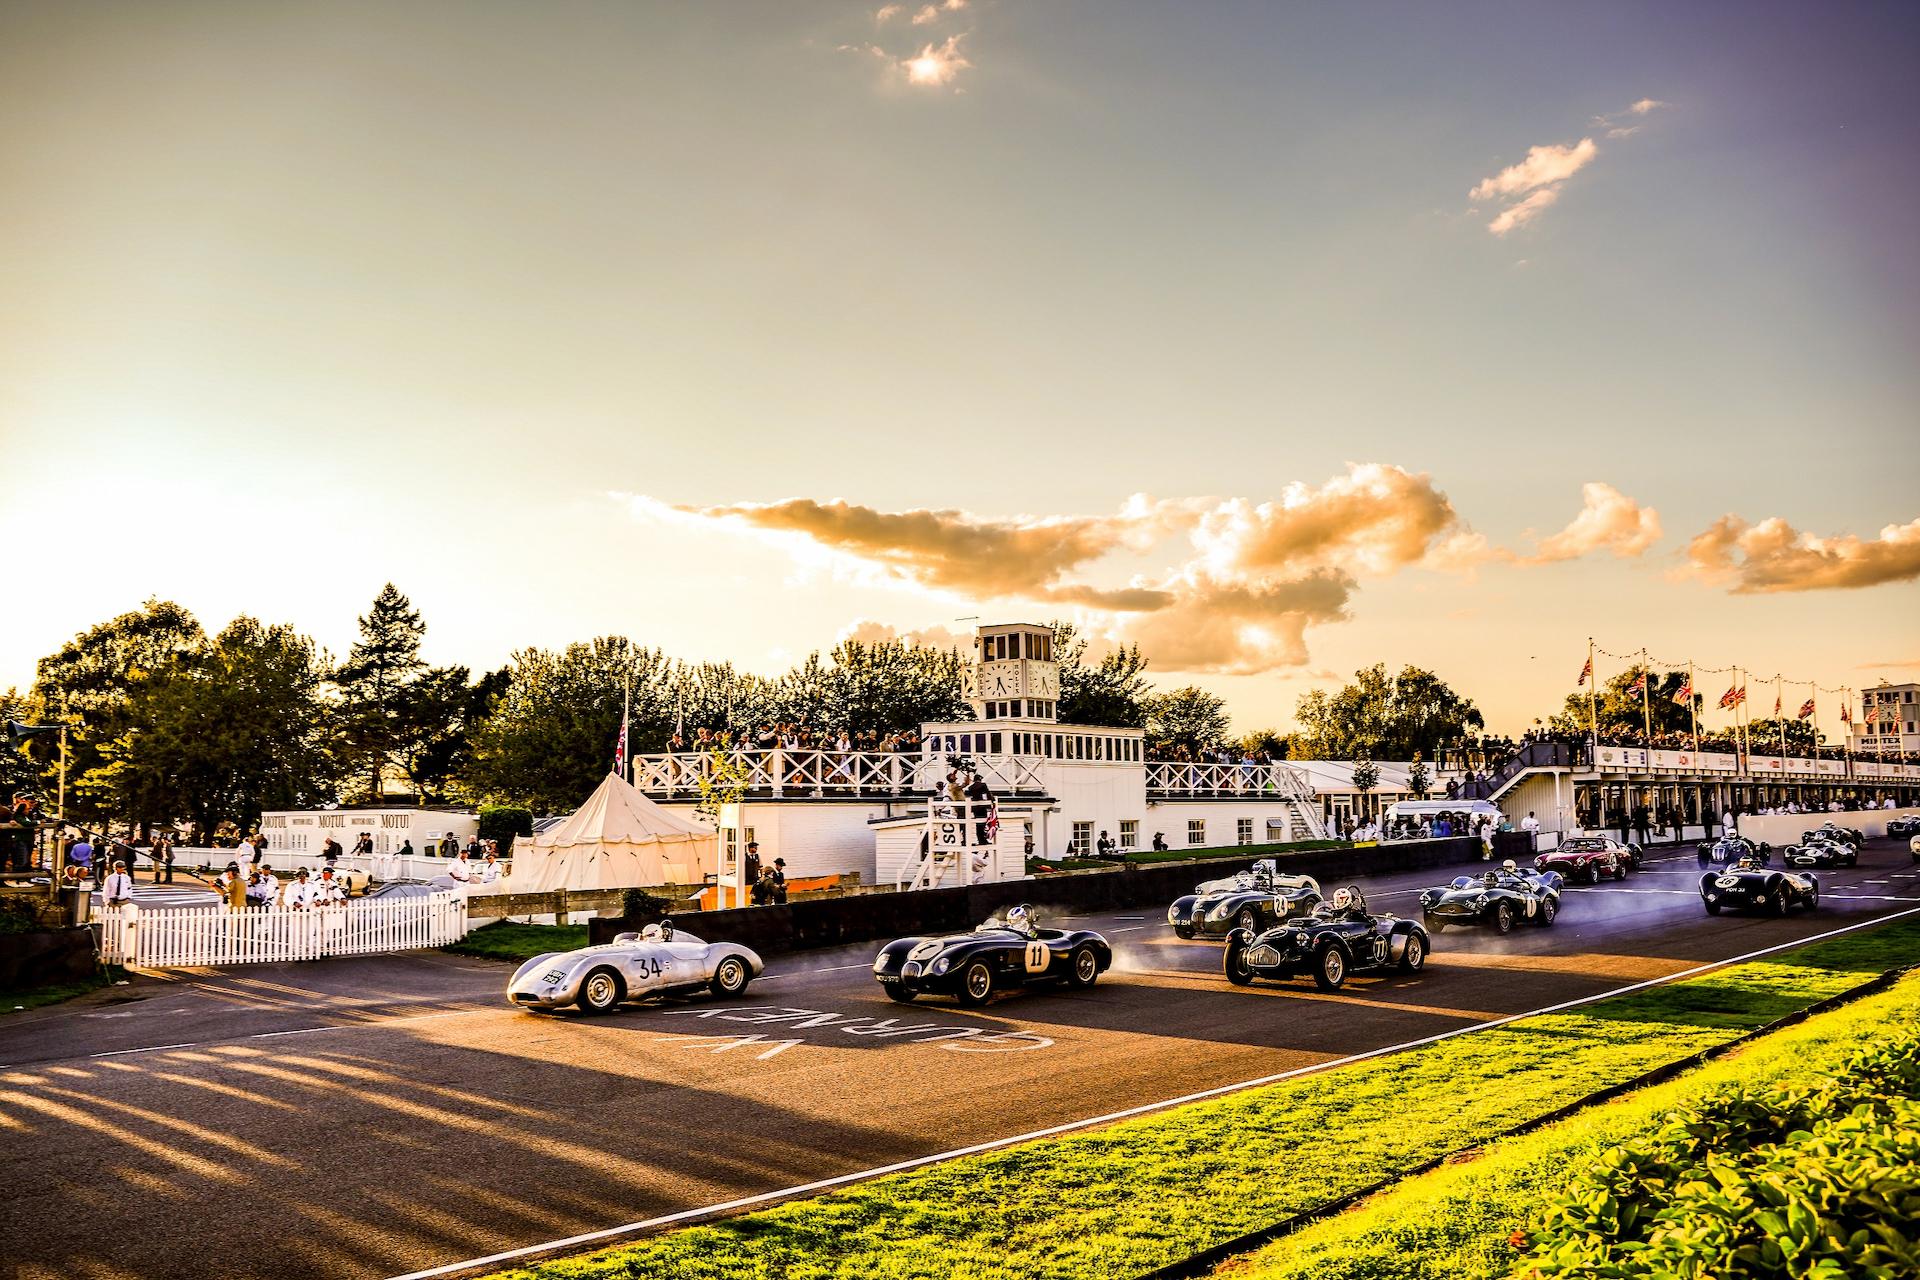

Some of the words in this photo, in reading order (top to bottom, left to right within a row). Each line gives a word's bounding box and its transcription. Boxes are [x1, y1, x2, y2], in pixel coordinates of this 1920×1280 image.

[263, 816, 287, 828] MOTUL
[318, 815, 346, 828] MOTUL
[1030, 946, 1042, 966] 11
[1376, 941, 1384, 957] 77
[634, 957, 662, 979] 34
